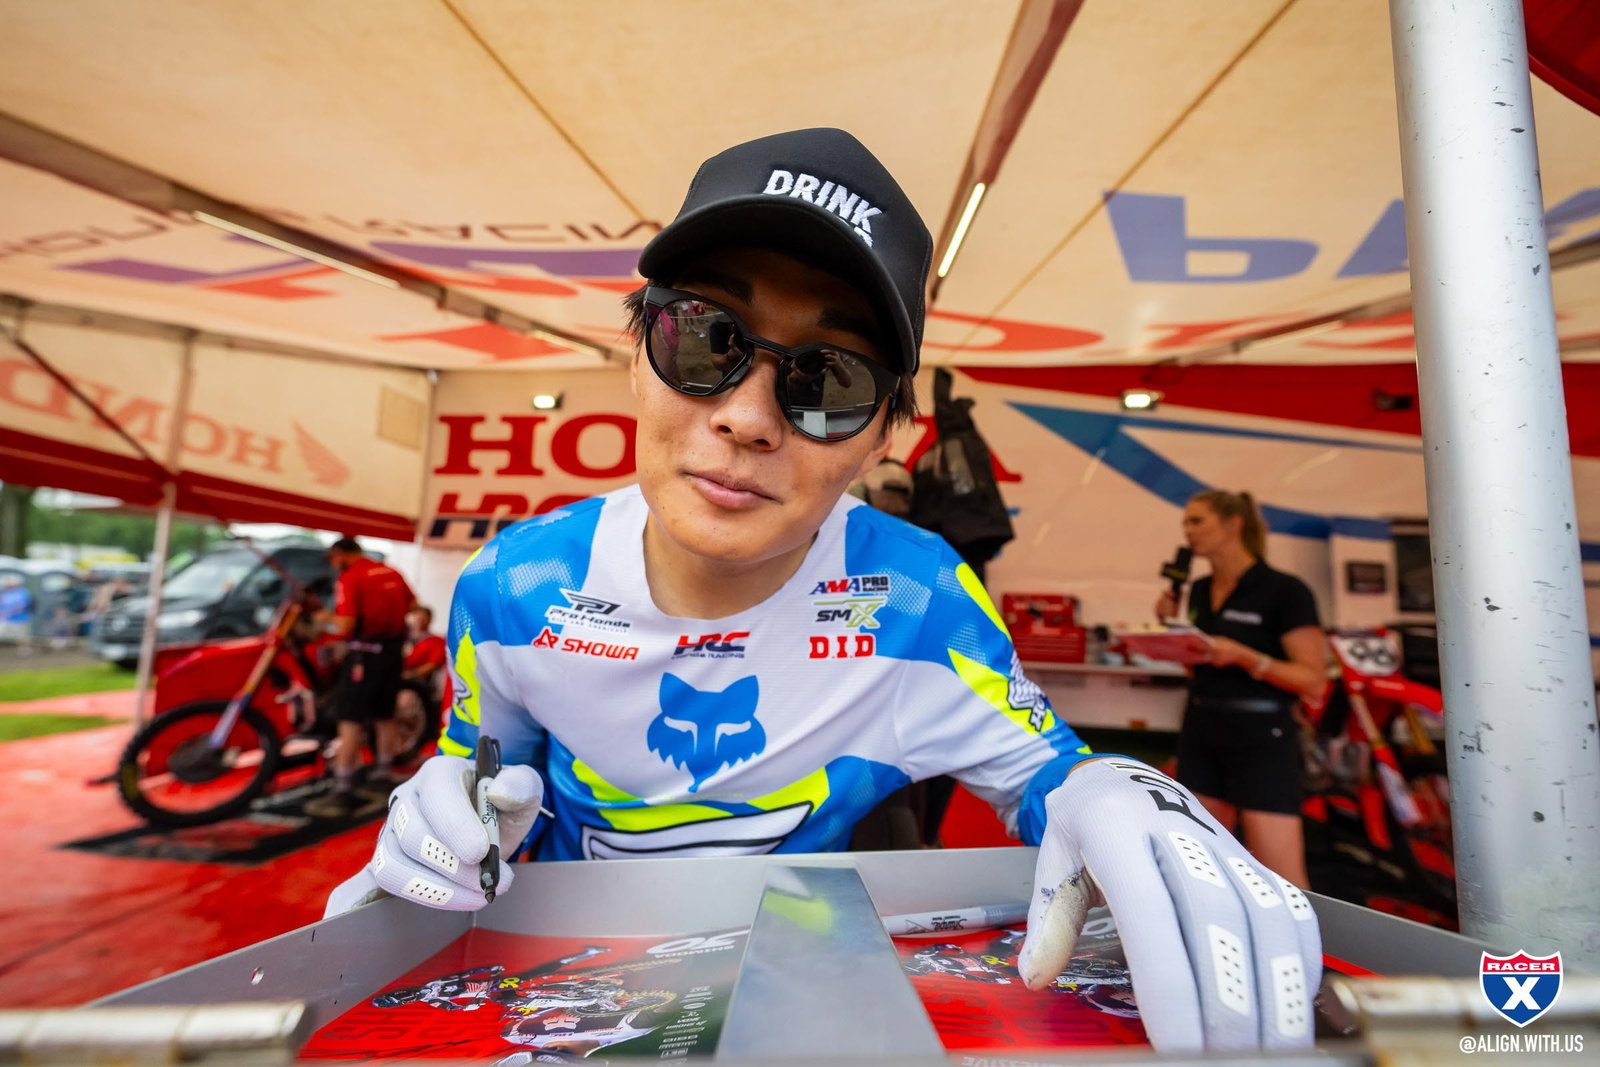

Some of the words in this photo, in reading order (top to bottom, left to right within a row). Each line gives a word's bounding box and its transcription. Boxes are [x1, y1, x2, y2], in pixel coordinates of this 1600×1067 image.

[762, 169, 883, 234] DRINK
[809, 577, 861, 595] AMA
[862, 576, 888, 586] PRO
[549, 608, 579, 620] Pro
[580, 614, 631, 629] Honda
[815, 603, 880, 628] SMX
[561, 638, 640, 661] SHOWA
[673, 631, 751, 656] HRC
[482, 798, 498, 828] Sharp
